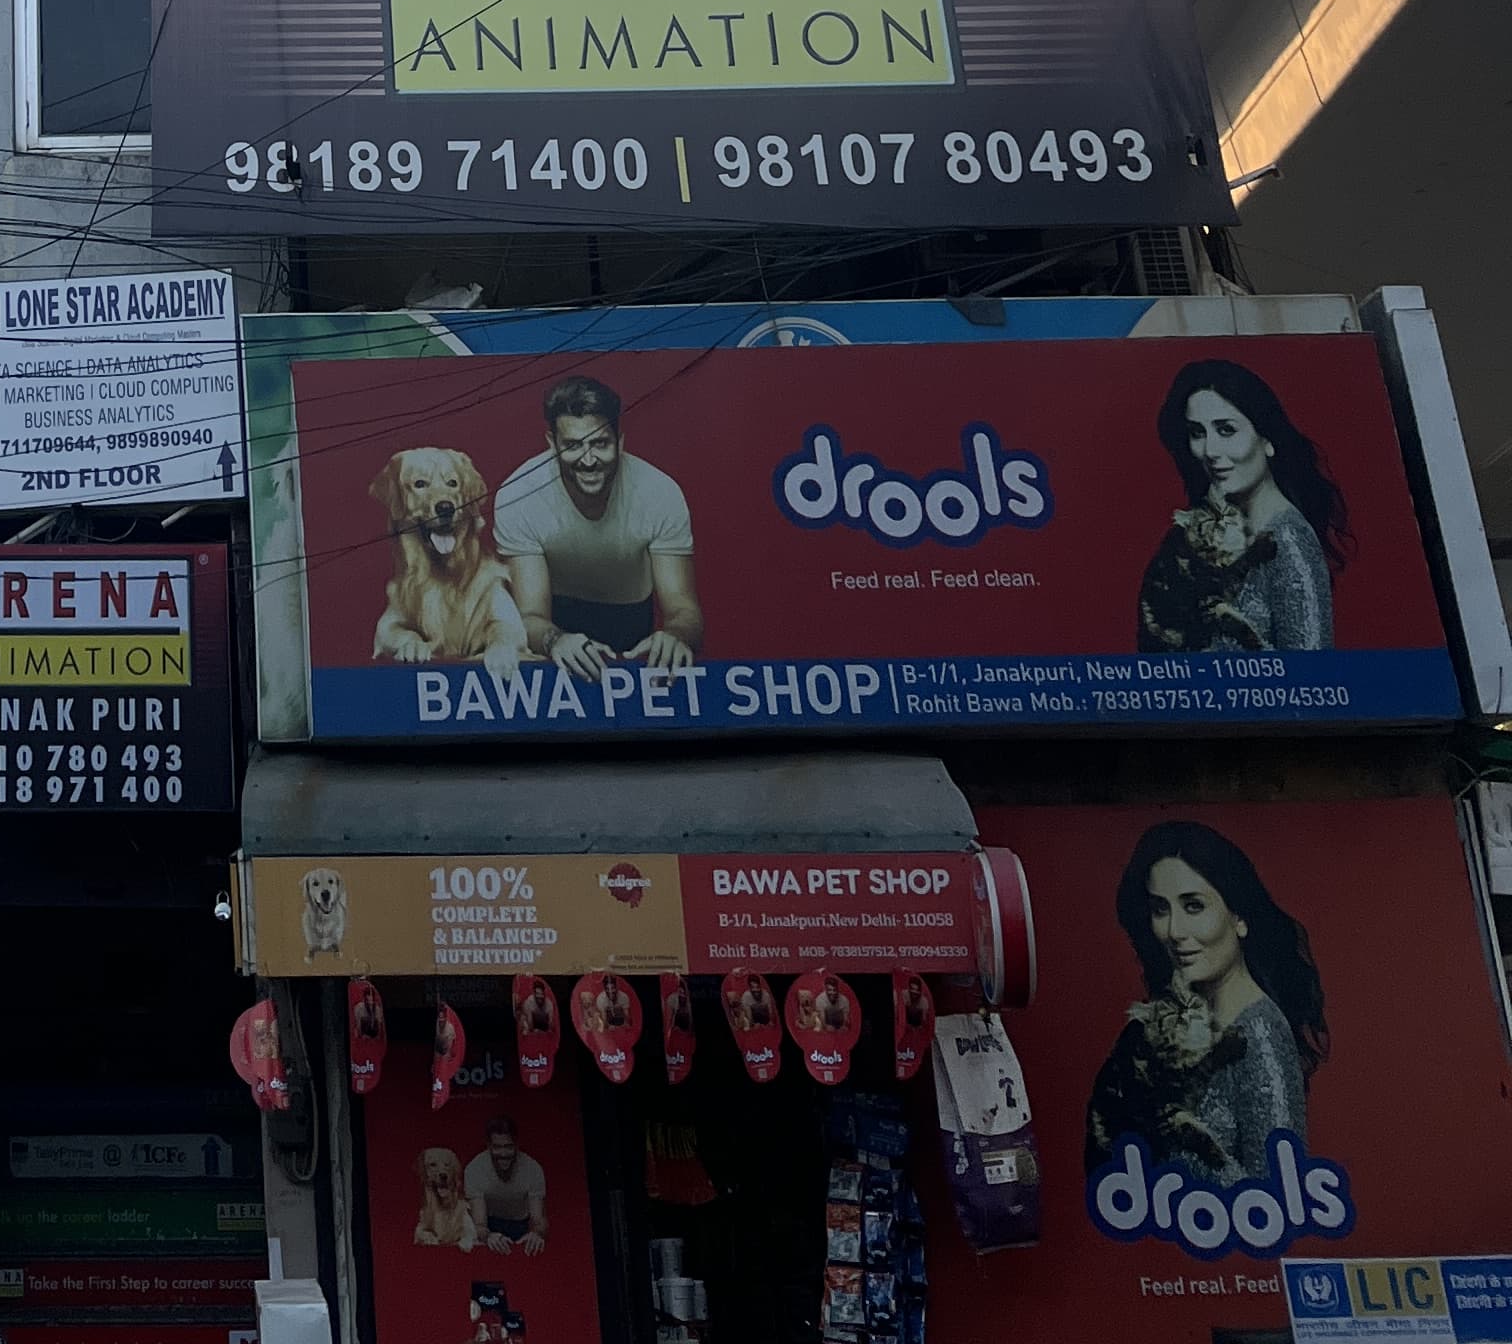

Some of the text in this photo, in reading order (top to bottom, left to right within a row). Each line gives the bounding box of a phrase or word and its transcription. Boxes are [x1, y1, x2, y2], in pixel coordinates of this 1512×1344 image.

[410, 9, 938, 73] ANIMATION
[224, 126, 1154, 195] 98189 71400 98107 80493
[5, 278, 226, 328] LONE STAR ACADEMY
[21, 464, 162, 491] 2ND FLOOR
[783, 430, 1047, 540] drools
[830, 564, 1042, 593] Feed real. Feed clean.
[417, 661, 881, 723] BAWA PET SHOP
[92, 698, 181, 731] PURI
[47, 745, 108, 771] 780
[121, 745, 182, 771] 493
[47, 776, 104, 802] 971
[121, 776, 183, 803] 400
[429, 867, 534, 901] 100%
[712, 868, 951, 896] BAWA PET SHOP
[432, 906, 537, 924] COMPLETE
[1096, 1140, 1346, 1249] drools
[1357, 1266, 1434, 1311] LIC
